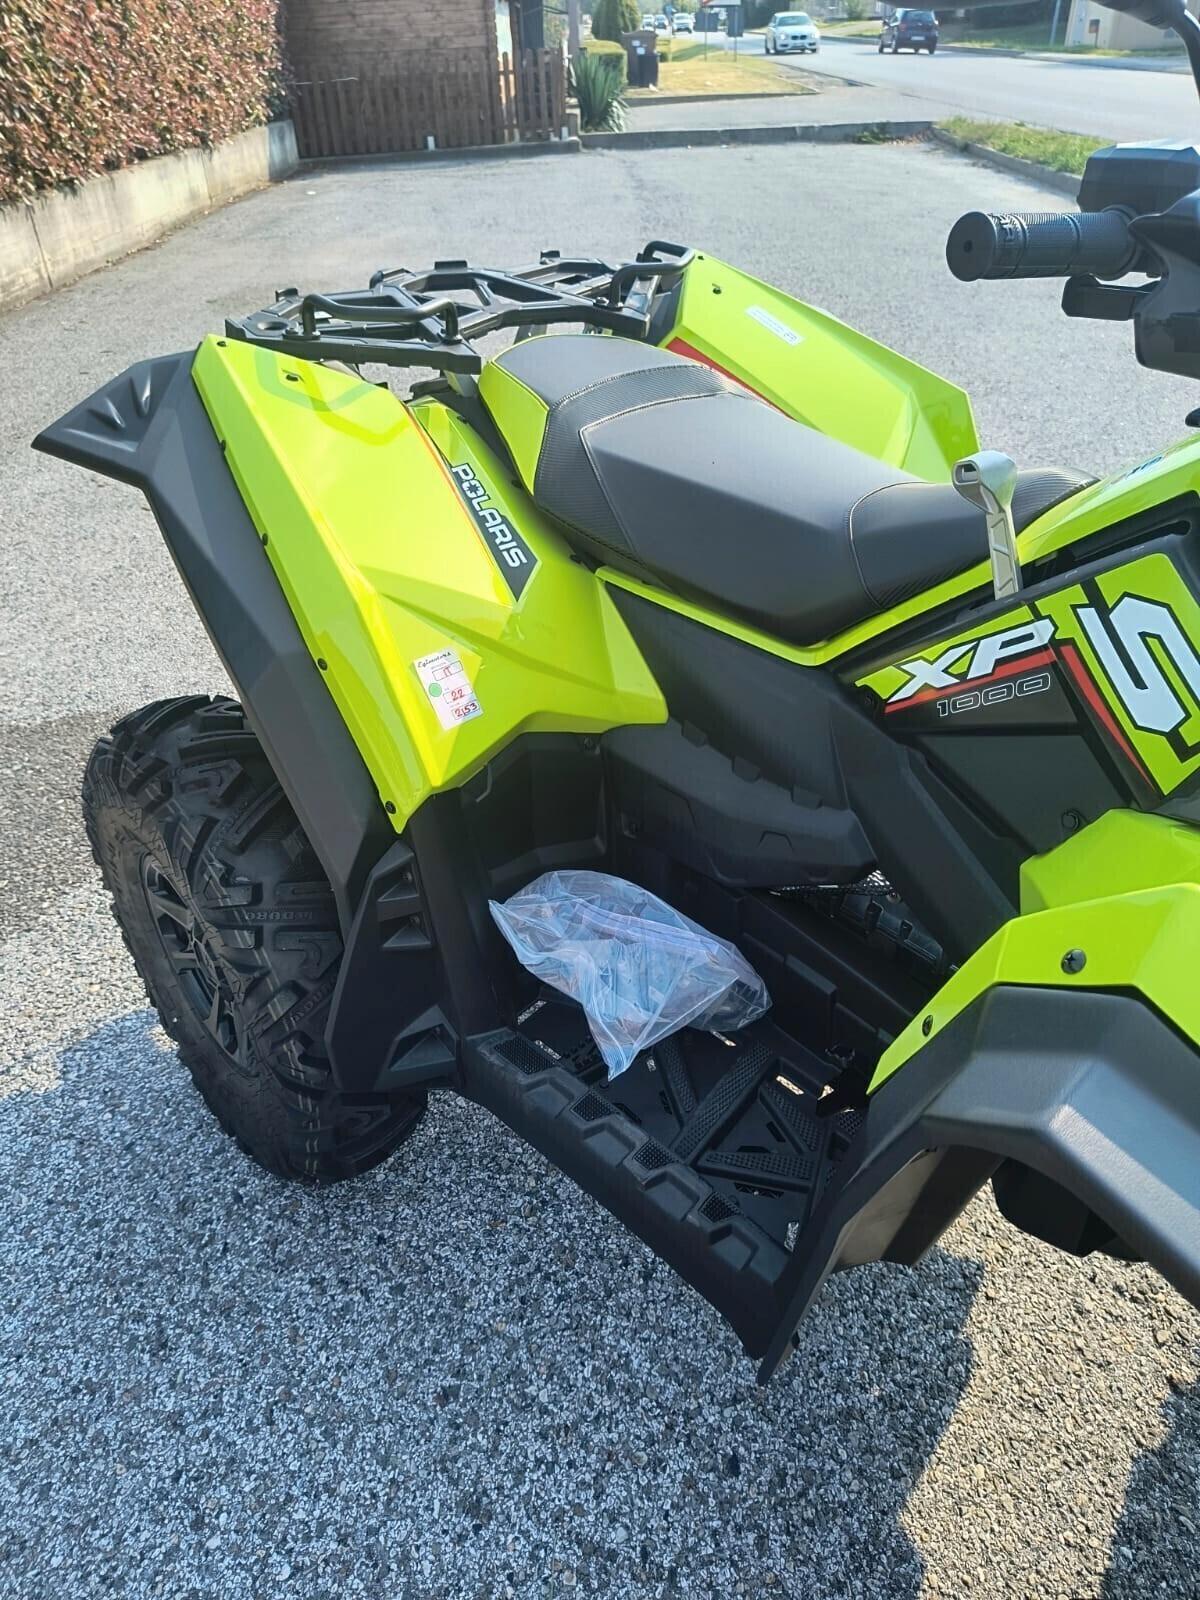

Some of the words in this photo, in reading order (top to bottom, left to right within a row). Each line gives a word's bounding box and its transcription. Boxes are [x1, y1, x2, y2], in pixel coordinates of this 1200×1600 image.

[451, 463, 528, 568] POLARIS
[887, 618, 1055, 703] XP
[451, 689, 464, 701] 22
[936, 672, 1051, 717] 1000
